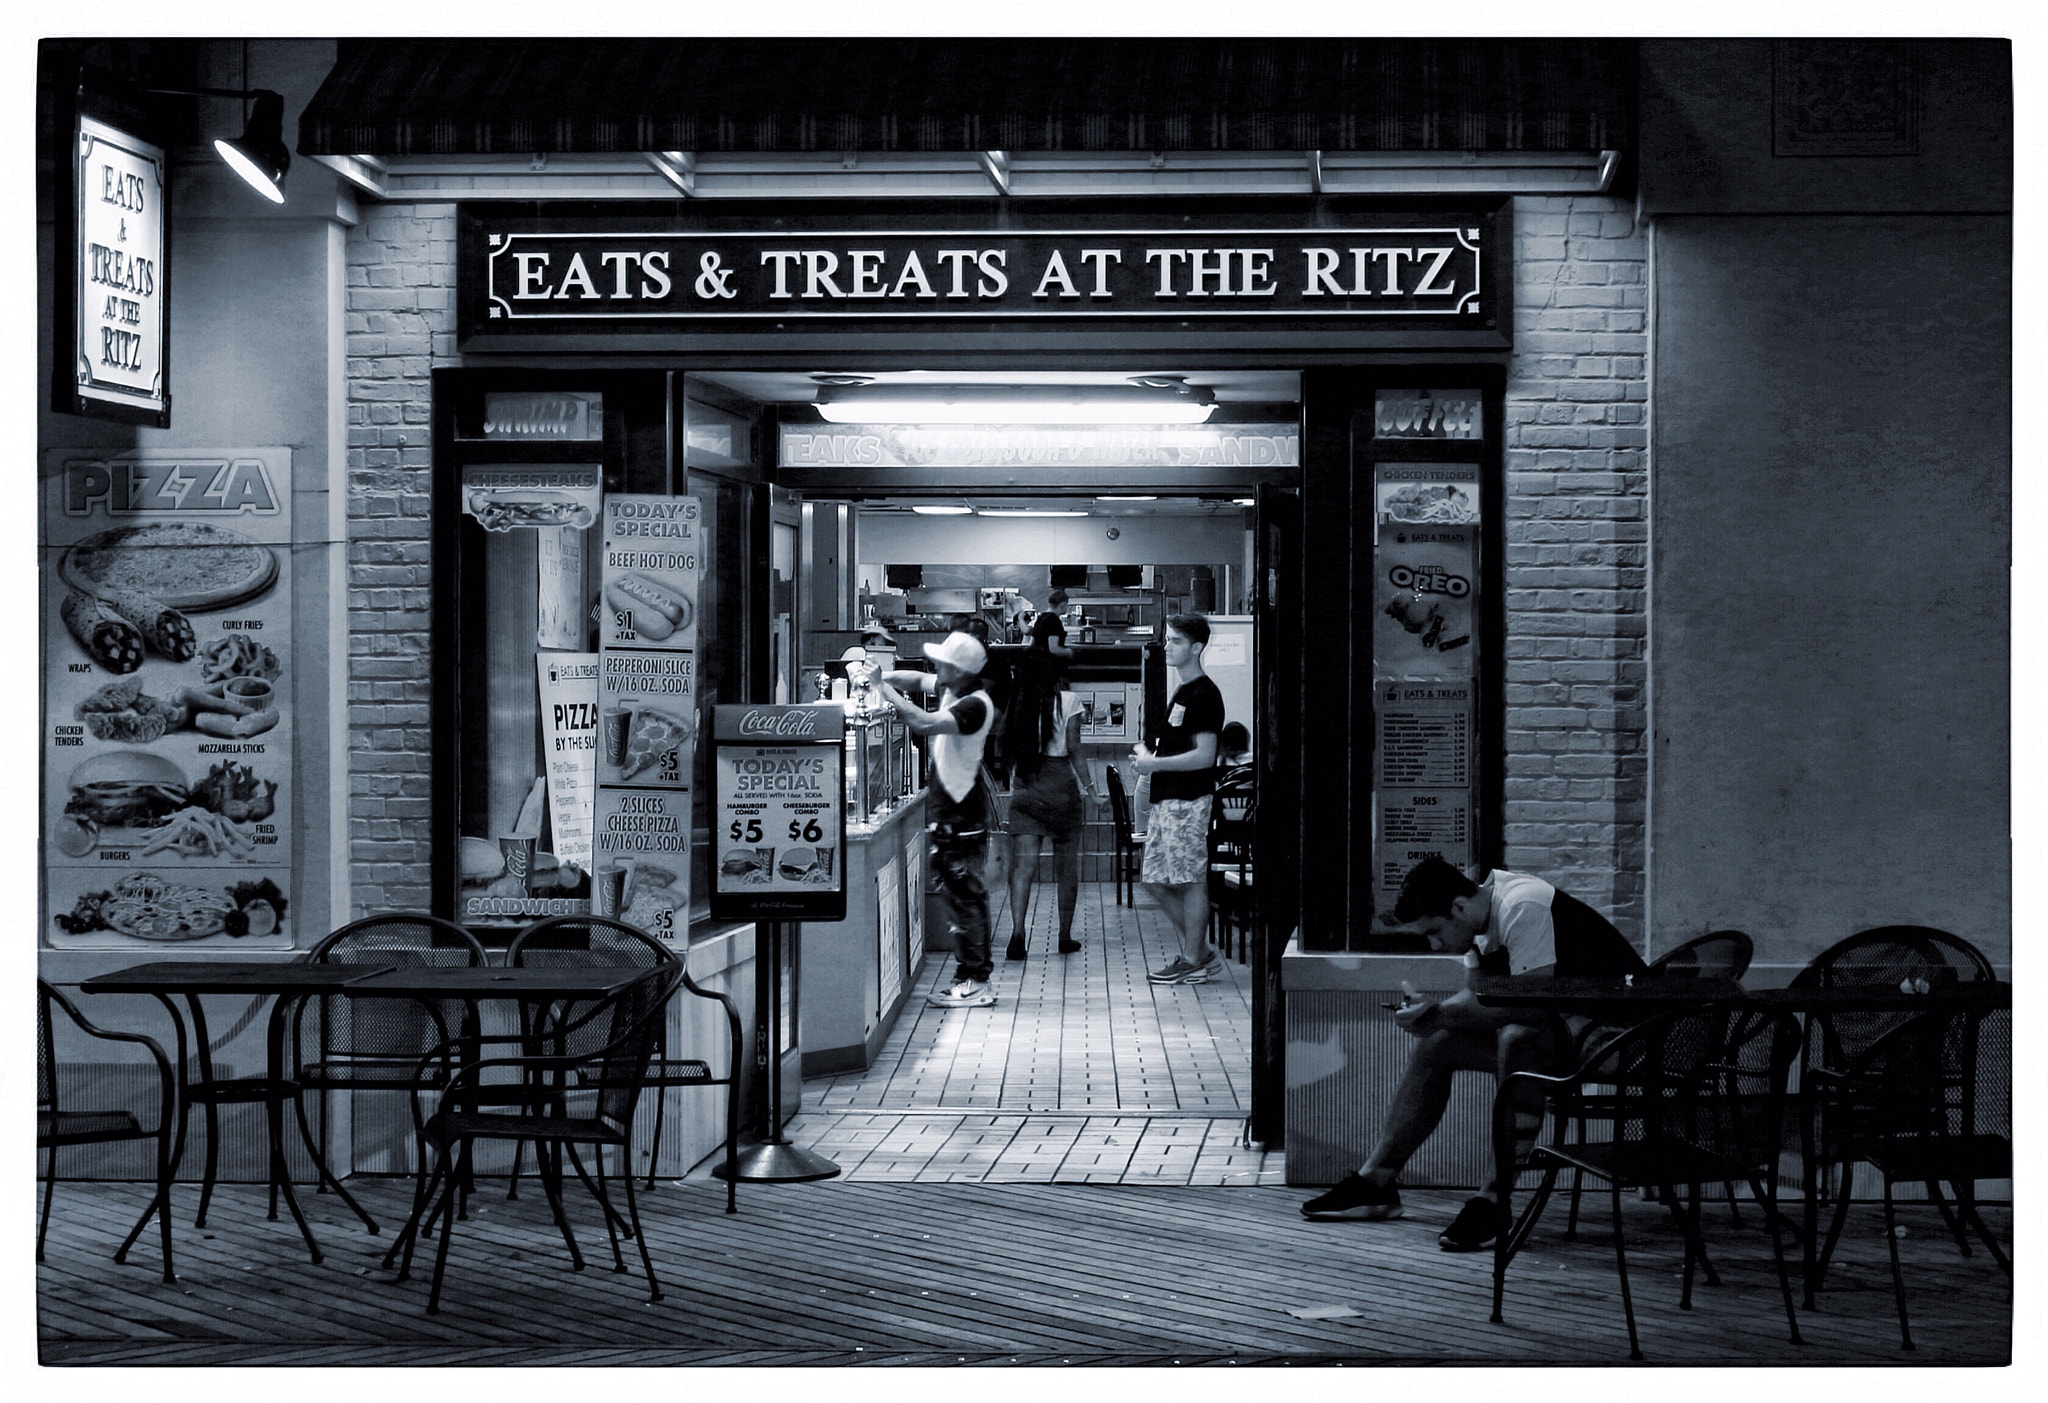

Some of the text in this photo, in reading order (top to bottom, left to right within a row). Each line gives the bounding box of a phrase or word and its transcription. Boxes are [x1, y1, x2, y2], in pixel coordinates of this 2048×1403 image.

[101, 164, 145, 213] EATS
[118, 217, 127, 242] &
[89, 242, 154, 297] TREATS
[512, 247, 1456, 300] EATS & TREATS AT THE RITZ
[102, 295, 140, 325] AT THE
[101, 326, 141, 372] RITZ
[469, 472, 595, 489] CHEESESTEAKS
[1384, 471, 1476, 480] CHICKEN TENDERS
[66, 458, 281, 517] PIZZA
[610, 502, 698, 520] TODAY'S
[615, 521, 692, 539] SPECIAL
[609, 552, 695, 570] BEEF HOT DOG
[1390, 566, 1470, 598] OREO
[222, 620, 263, 630] CURLY FRIES
[616, 610, 633, 630] $1
[68, 663, 91, 673] WRAPS
[606, 657, 691, 675] PEPPERONI SLICE
[606, 675, 690, 694] W/16 OZ. SODA
[1404, 689, 1468, 698] EATS & TREATS
[553, 702, 598, 731] PIZZA
[739, 710, 819, 736] Coca-Cola
[55, 725, 84, 735] CHICKEN
[55, 736, 84, 746] TENDERS
[198, 743, 265, 754] MOZZARELLA STICKS
[555, 737, 566, 751] BY
[568, 736, 582, 750] THE
[660, 751, 679, 771] $5
[732, 759, 824, 775] TODAY'S
[659, 771, 679, 781] +TAX
[737, 775, 821, 791] SPECIAL
[621, 796, 664, 814] 2 SLICES
[1412, 796, 1438, 806] SIDES
[255, 824, 275, 834] FRIED
[608, 815, 679, 833] CHEESE PIZZA
[730, 819, 764, 843] $5
[788, 818, 823, 843] $6
[252, 835, 278, 845] SHRIMP
[600, 832, 686, 853] W/16 OZ. SODA
[100, 851, 131, 861] BURGERS
[655, 910, 674, 929] $5
[654, 930, 675, 940] +TAX
